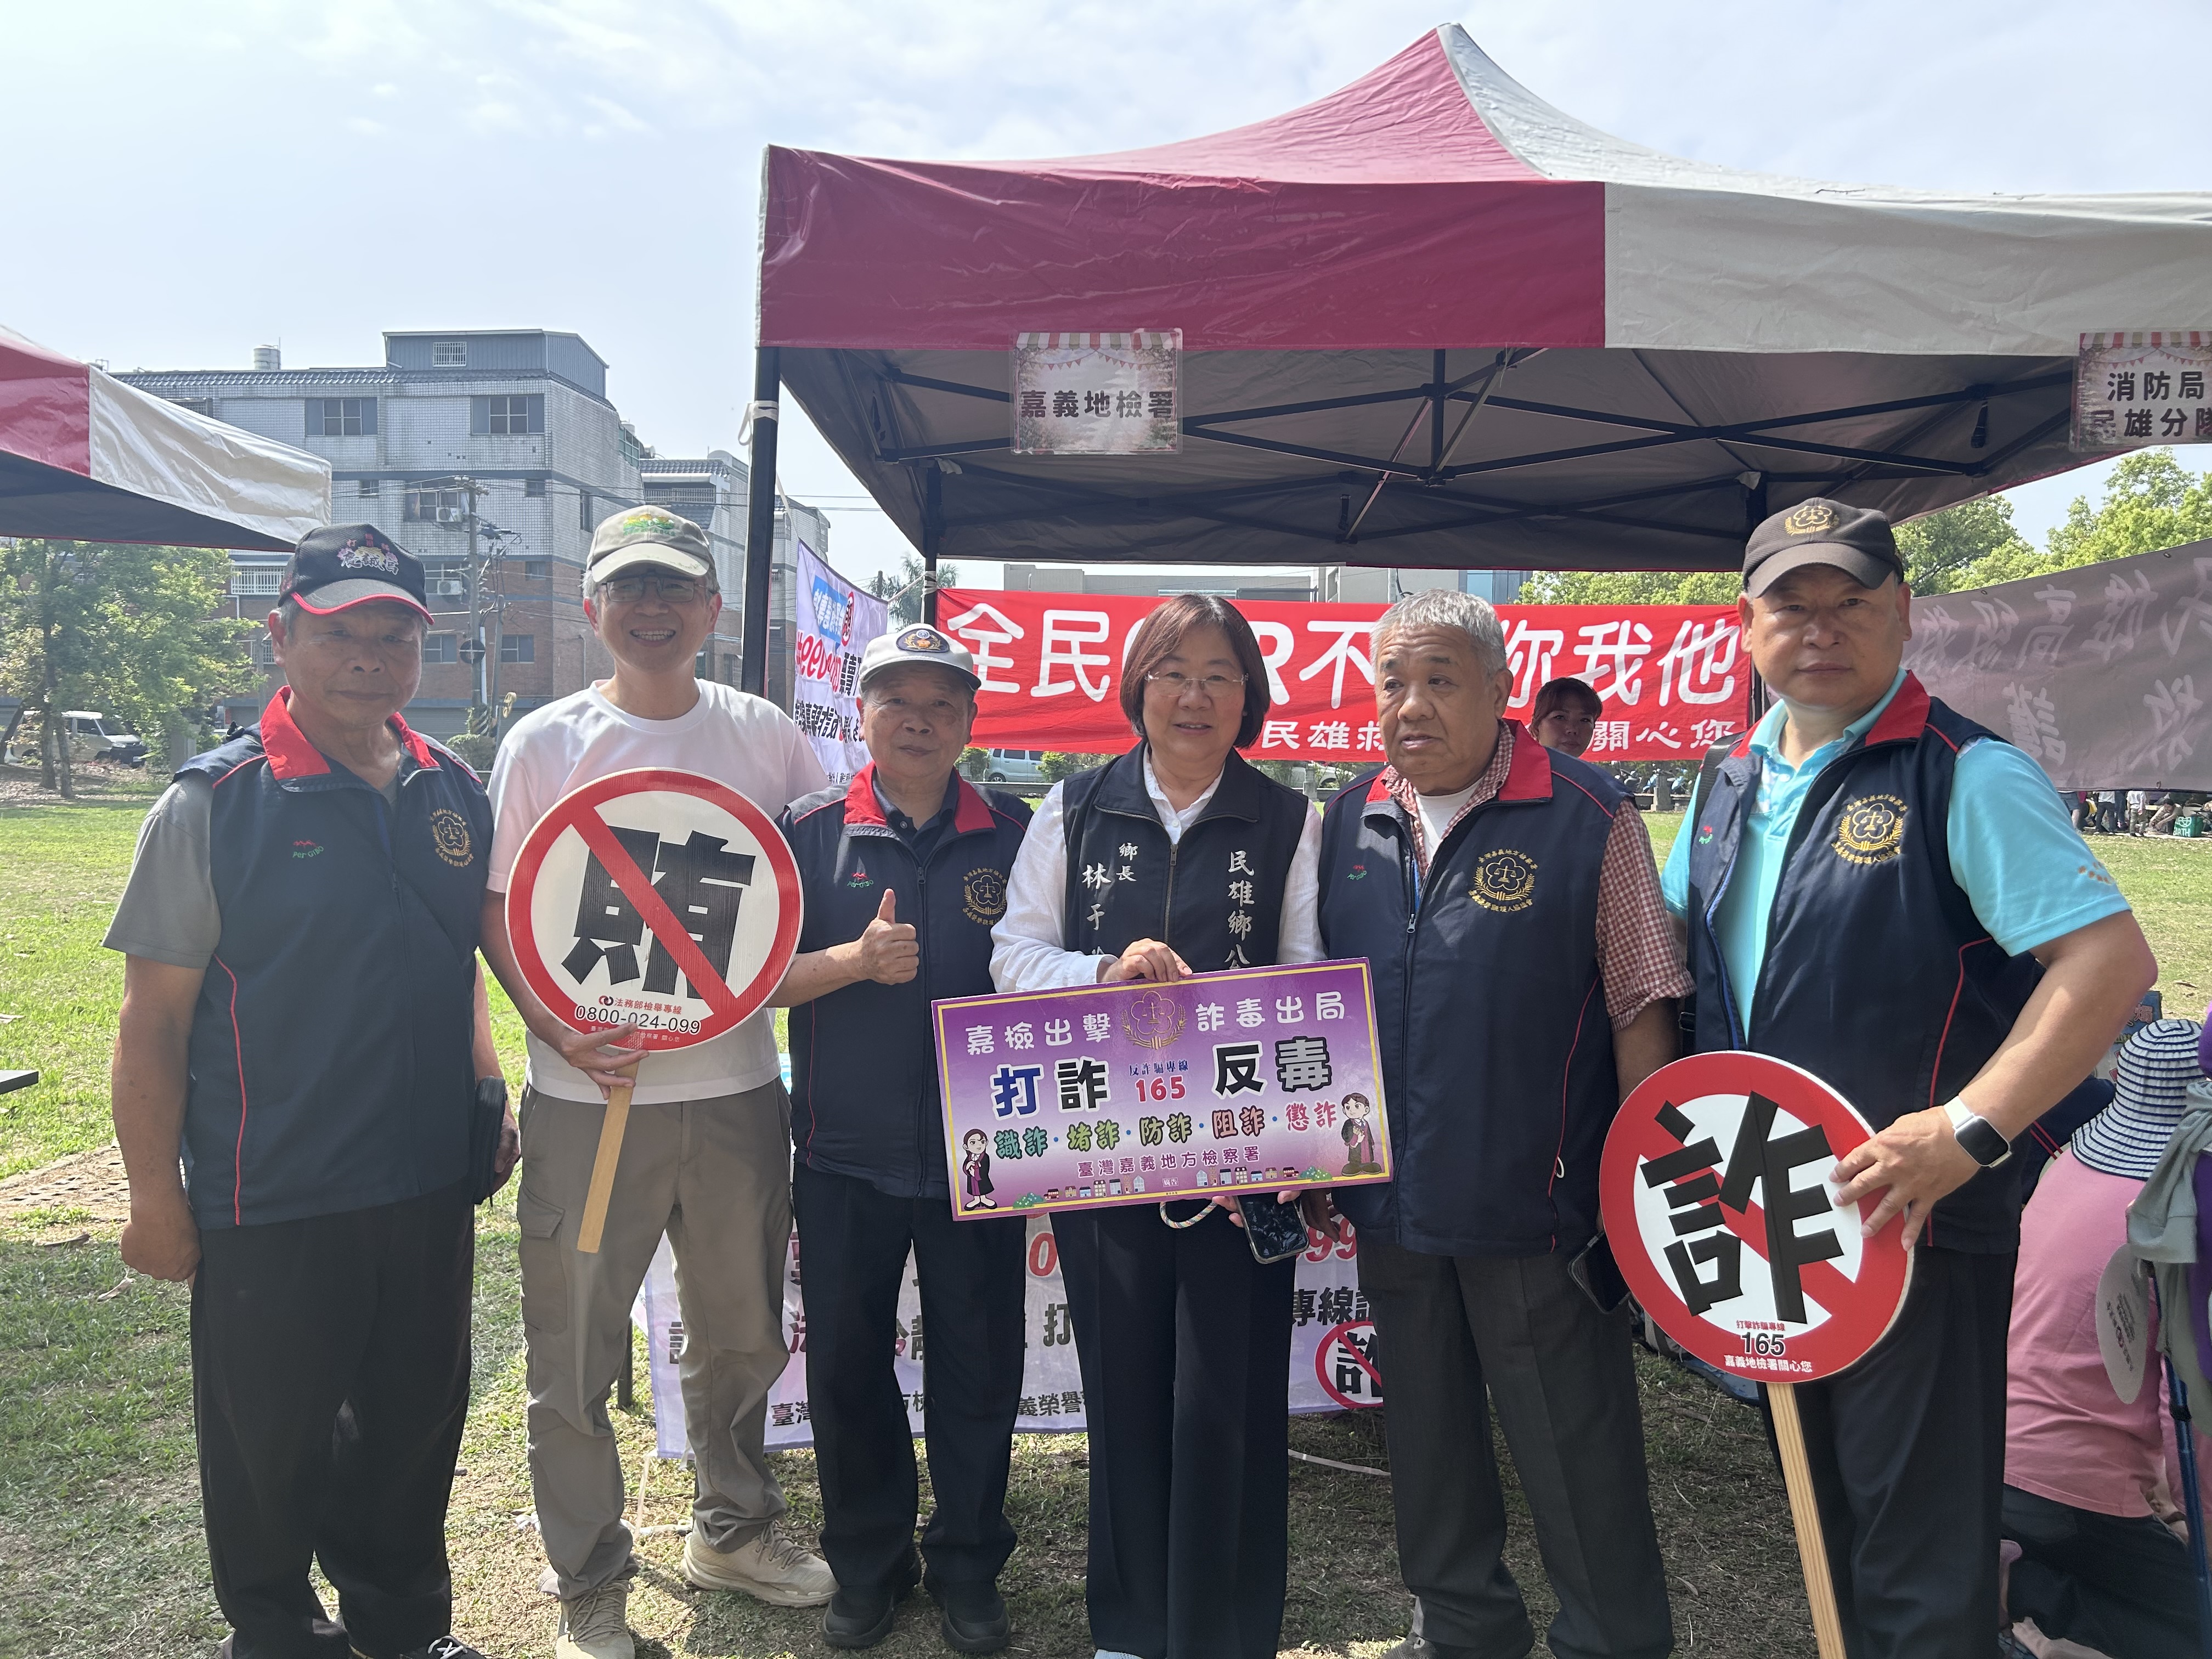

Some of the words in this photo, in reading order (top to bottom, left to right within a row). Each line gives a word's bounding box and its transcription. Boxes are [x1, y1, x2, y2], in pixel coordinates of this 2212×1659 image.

[2107, 370, 2204, 402] 消防局
[1020, 390, 1174, 419] 嘉義地檢署
[1116, 842, 1138, 882] 鄉長
[561, 824, 756, 1000] 賄
[1082, 862, 1111, 955] 林于
[1224, 850, 1256, 970] 民雄鄉公
[575, 1005, 701, 1035] 0800-024-099
[614, 997, 682, 1015] 法務部檢舉專線
[965, 1013, 1111, 1056] 嘉檢出擊
[1195, 991, 1345, 1032] 詐毒出局
[991, 1058, 1110, 1119] 打詐
[1213, 1035, 1333, 1097] 反毒
[1135, 1076, 1186, 1102] 165
[1066, 1119, 1120, 1152] 堵詐
[1139, 1111, 1193, 1147] 防詐
[1211, 1105, 1266, 1140] 阻詐
[1077, 1146, 1260, 1178] 臺灣嘉義地方檢察署
[1639, 1090, 1844, 1324] 詐
[1736, 1319, 1786, 1331] 打擊詐騙專線
[1741, 1331, 1785, 1356] 165
[1723, 1355, 1813, 1373] 嘉義地檢署關心您
